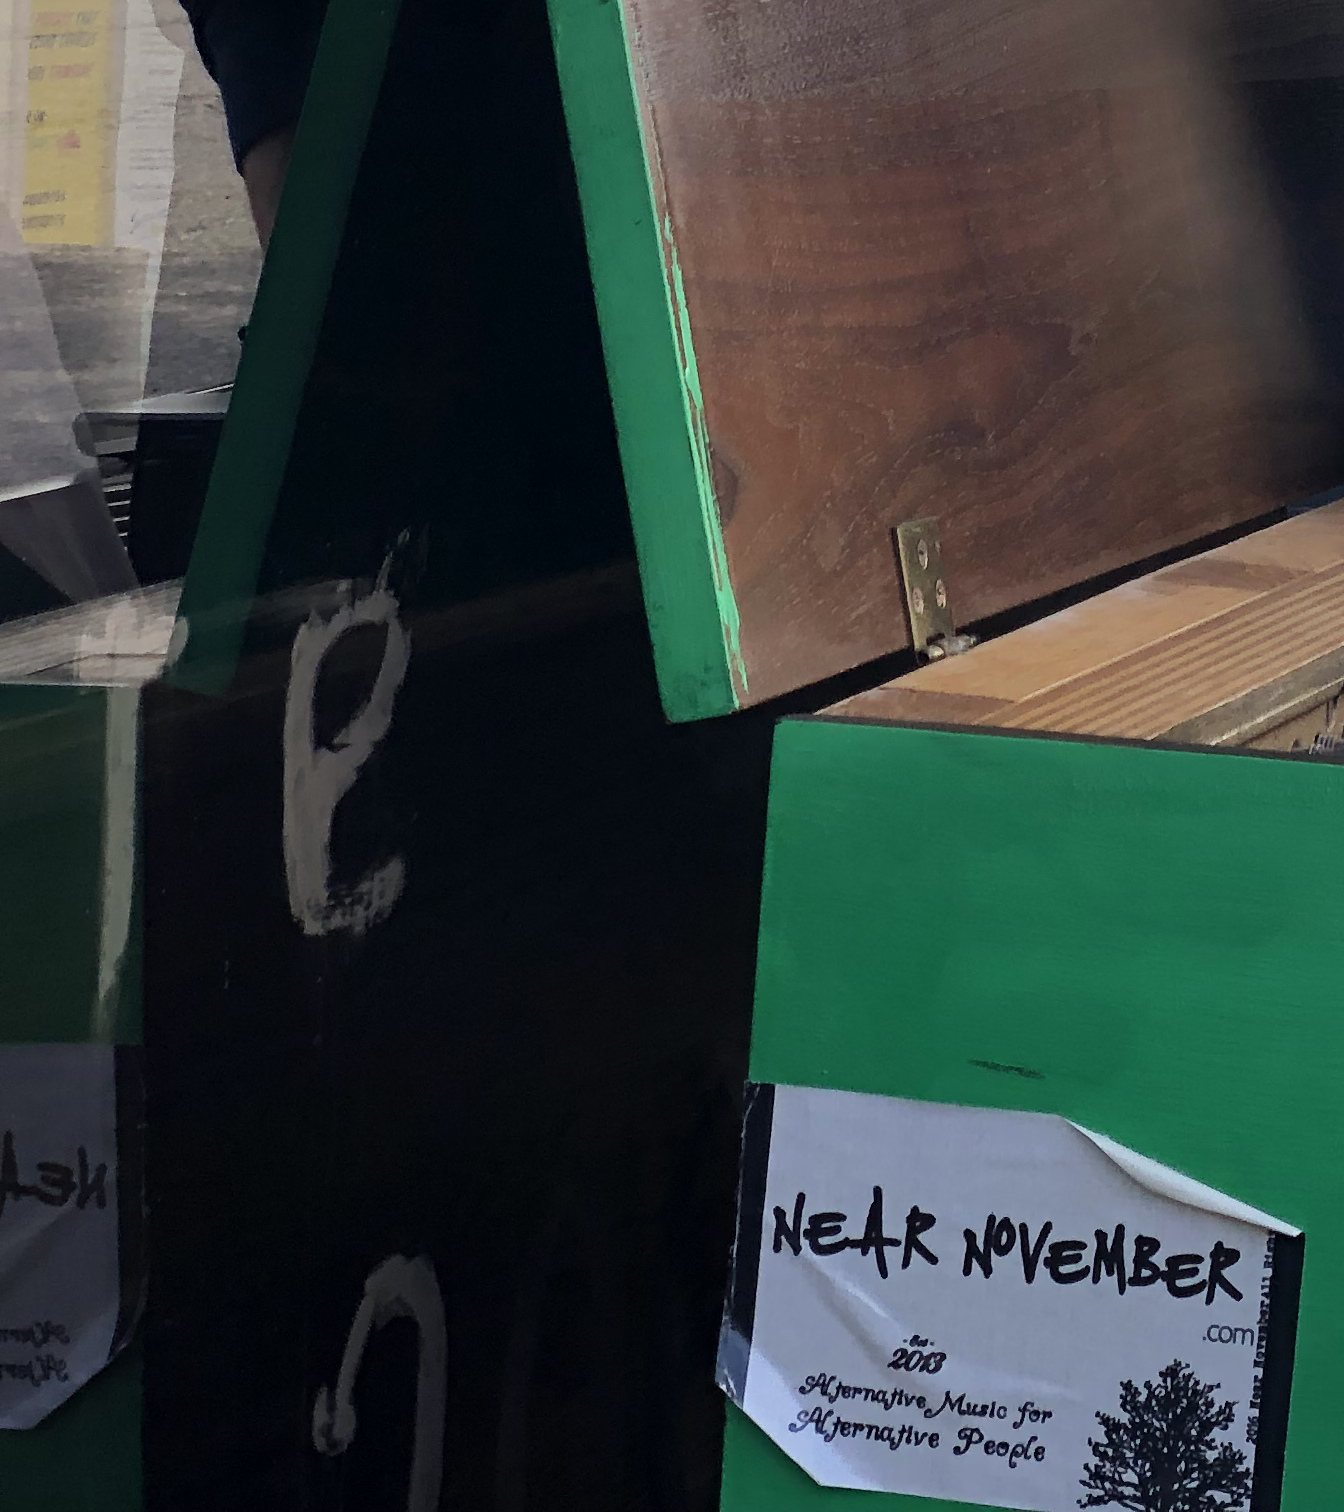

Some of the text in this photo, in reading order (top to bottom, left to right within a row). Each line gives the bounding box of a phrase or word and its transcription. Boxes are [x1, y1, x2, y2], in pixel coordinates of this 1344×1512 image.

[772, 1185, 1243, 1305] NEAR NOVEMBER
[887, 1348, 947, 1374] 2013
[1202, 1324, 1255, 1345] .com
[799, 1373, 1053, 1429] Alternative Music for
[788, 1406, 1046, 1469] Alternative People
